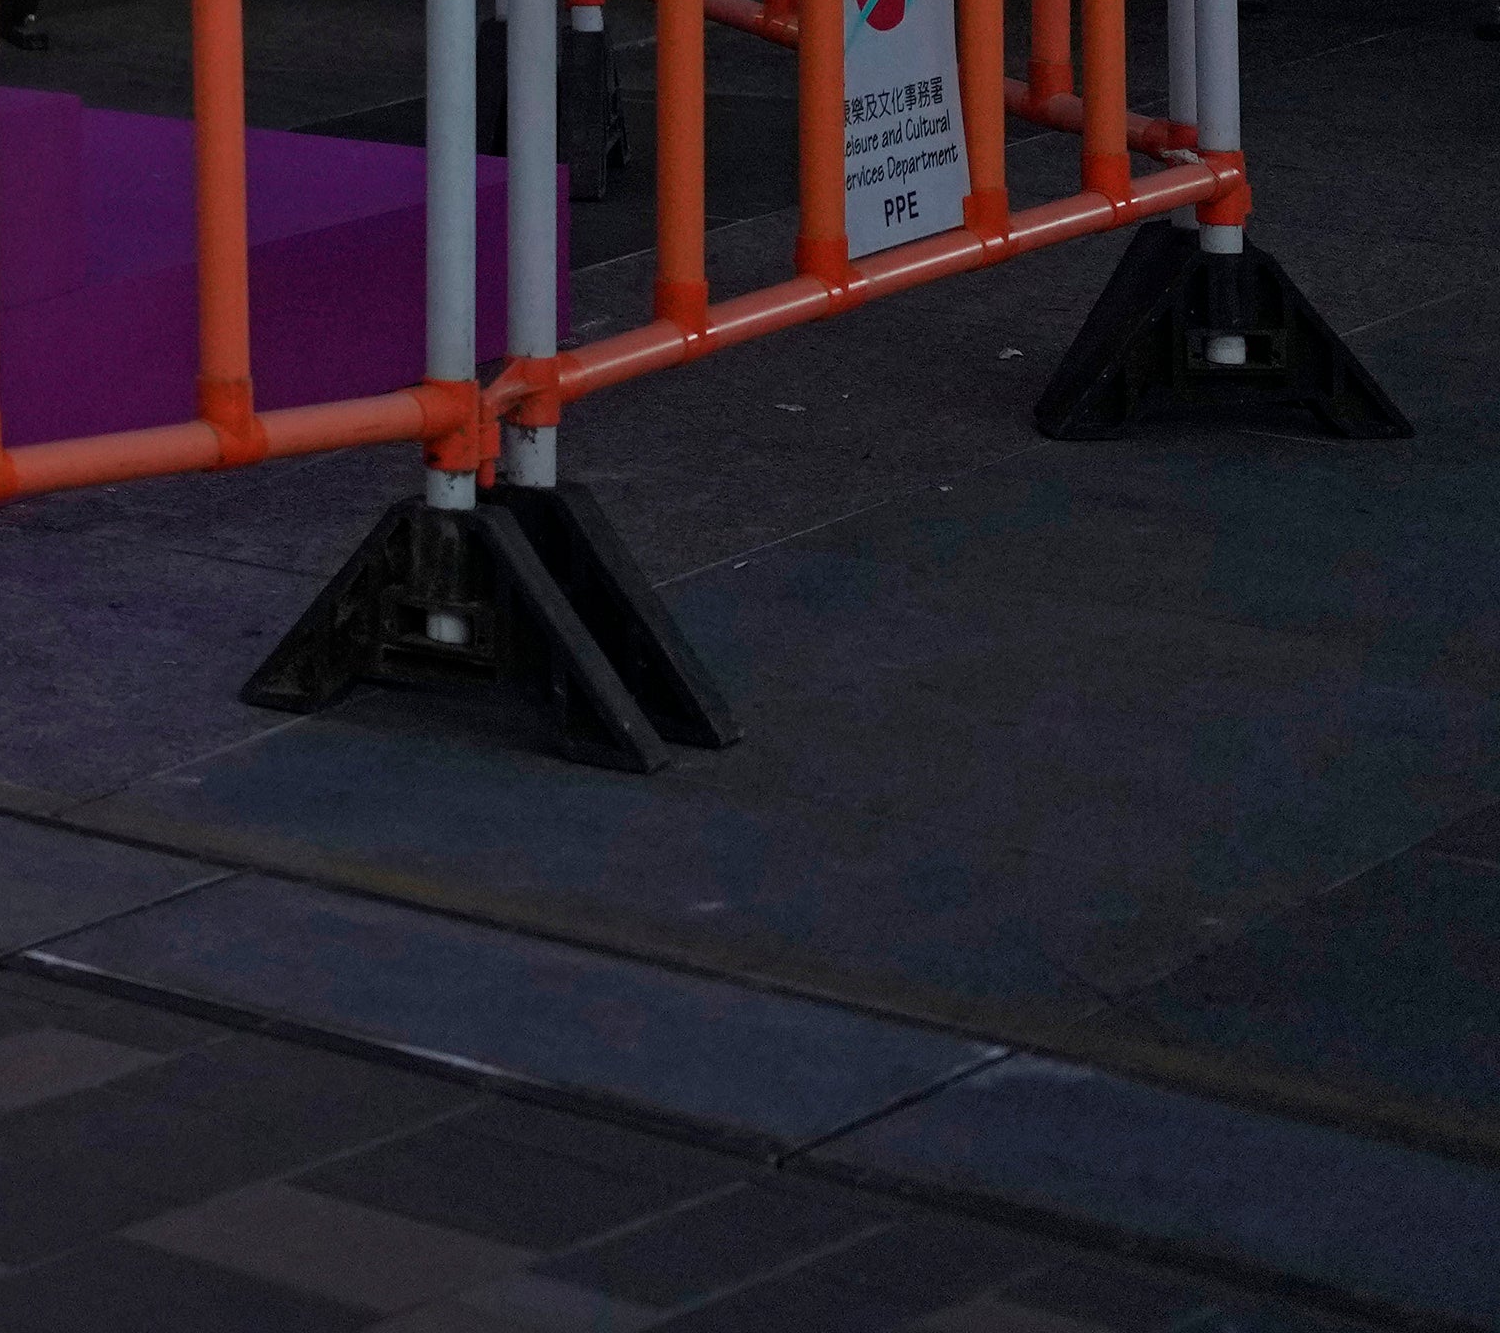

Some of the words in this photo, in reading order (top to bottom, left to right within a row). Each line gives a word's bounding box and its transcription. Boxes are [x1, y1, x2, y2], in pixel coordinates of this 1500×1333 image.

[845, 133, 879, 157] eisure
[882, 121, 903, 148] and
[905, 109, 951, 141] Cultural
[846, 165, 885, 191] ervices
[887, 143, 959, 184] Department
[884, 190, 919, 227] PPE
